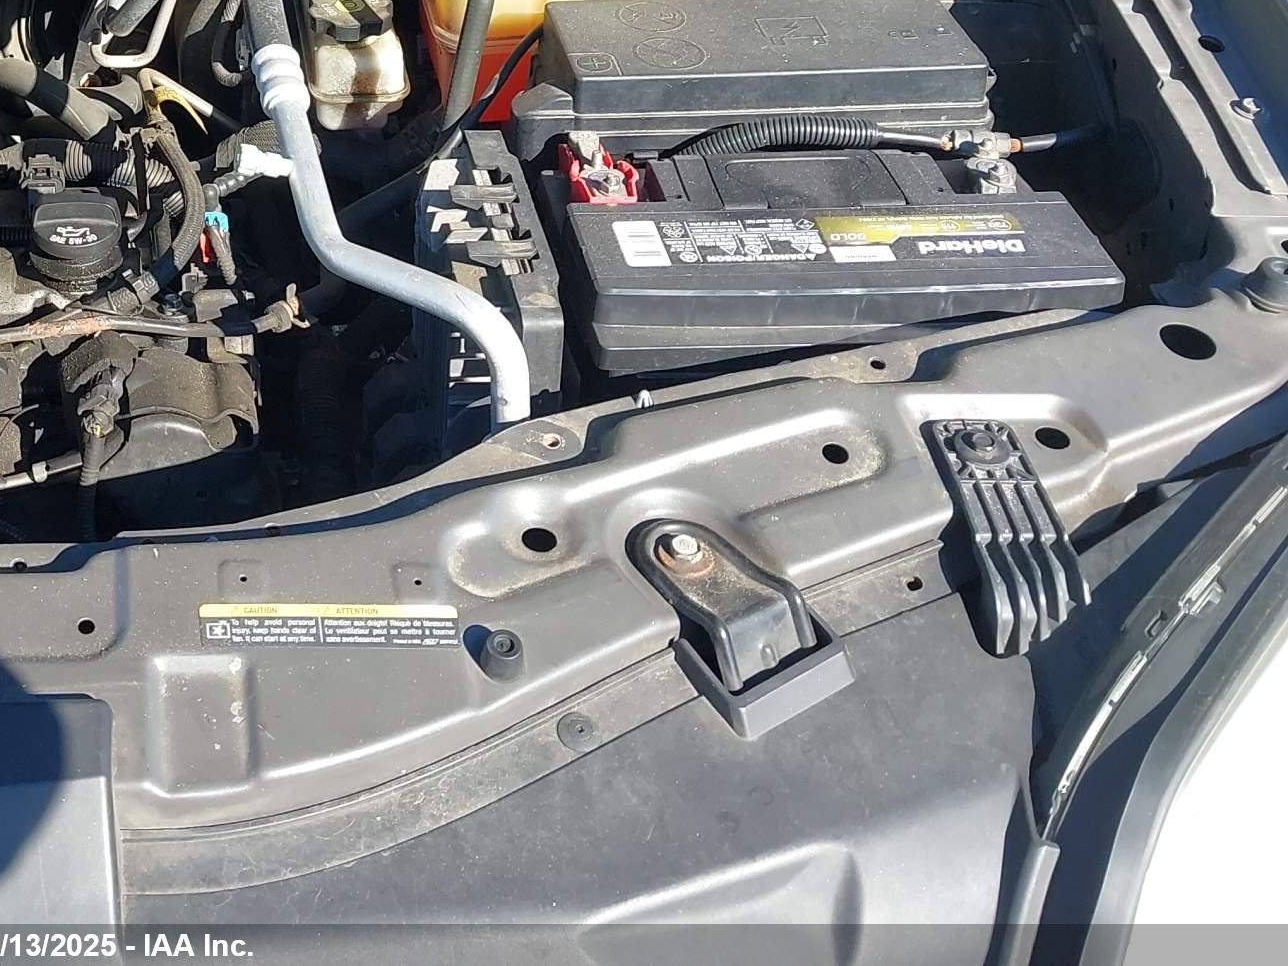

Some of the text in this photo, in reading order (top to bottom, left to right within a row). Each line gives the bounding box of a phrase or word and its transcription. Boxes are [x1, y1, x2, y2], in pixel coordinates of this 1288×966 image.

[830, 233, 866, 241] GOLD
[918, 239, 1026, 255] DieHard
[336, 607, 379, 615] ATTENTION
